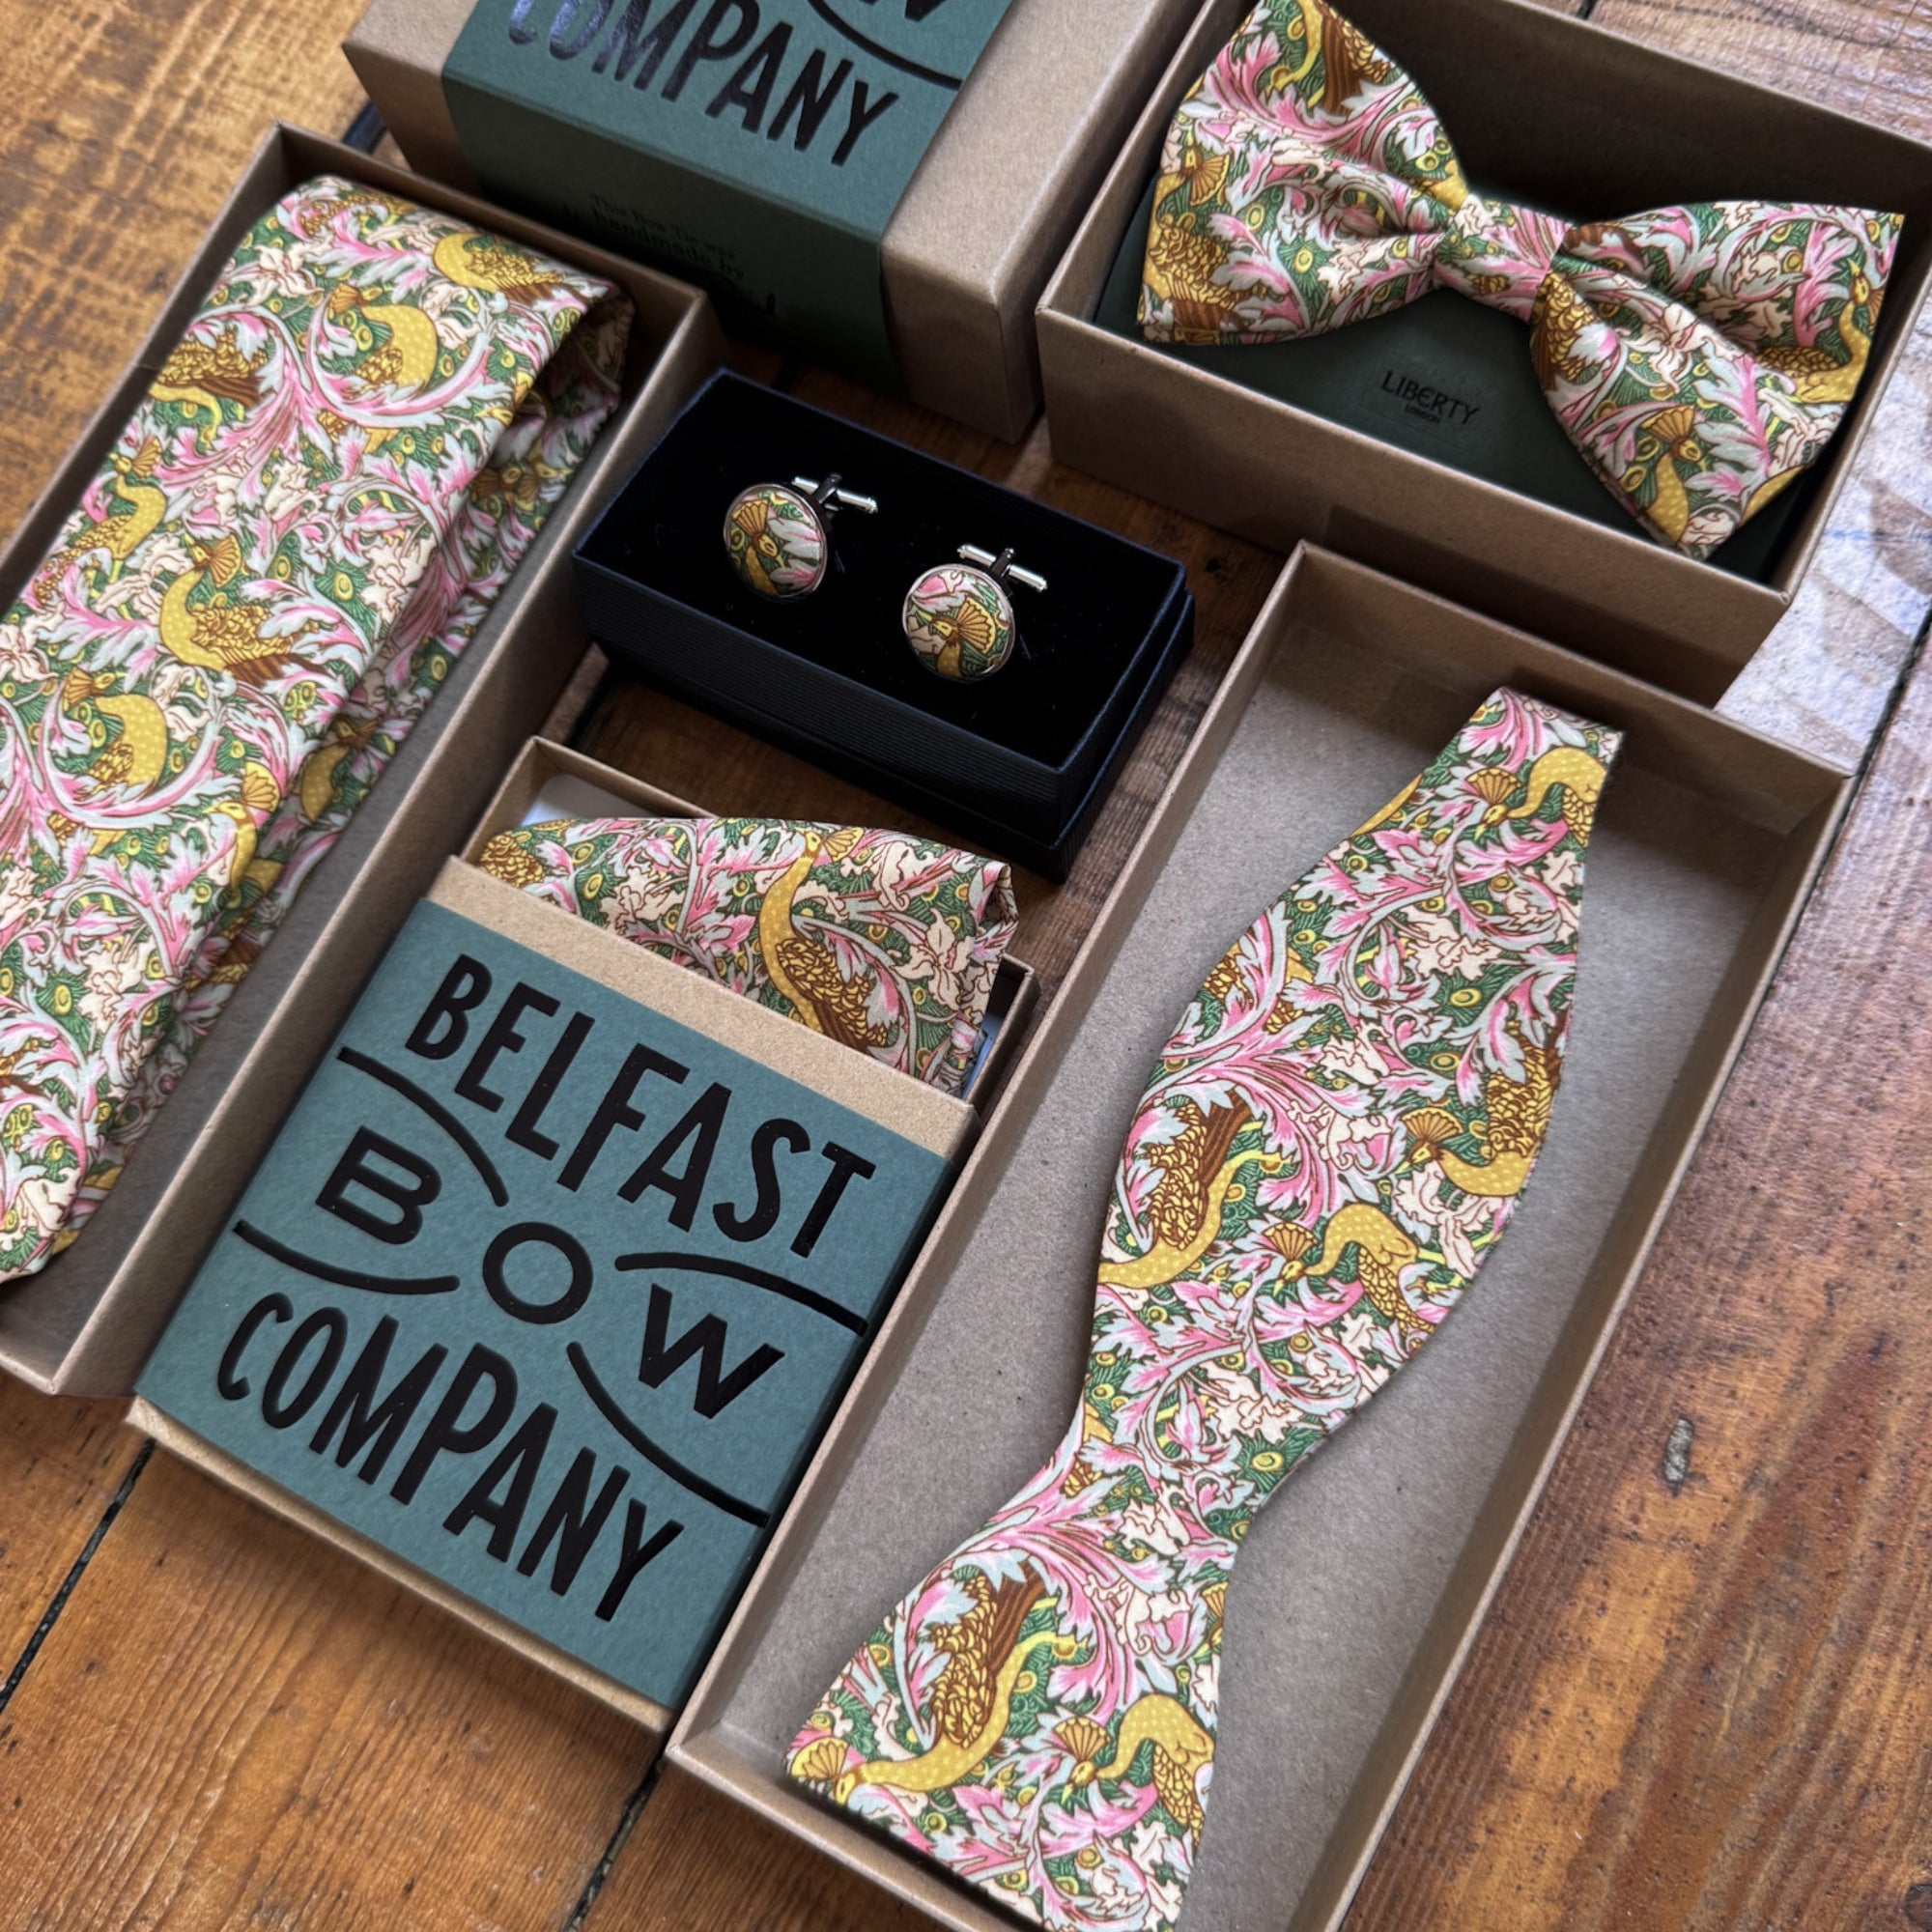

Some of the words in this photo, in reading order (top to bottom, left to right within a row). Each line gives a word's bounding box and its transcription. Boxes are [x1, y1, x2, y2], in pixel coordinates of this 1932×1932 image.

[507, 0, 899, 167] COMPANY
[719, 257, 745, 281] by
[1380, 370, 1480, 425] LIBERTY
[405, 952, 877, 1259] BELFAST
[314, 1125, 786, 1420] BOW
[215, 1292, 685, 1623] COMPANY
